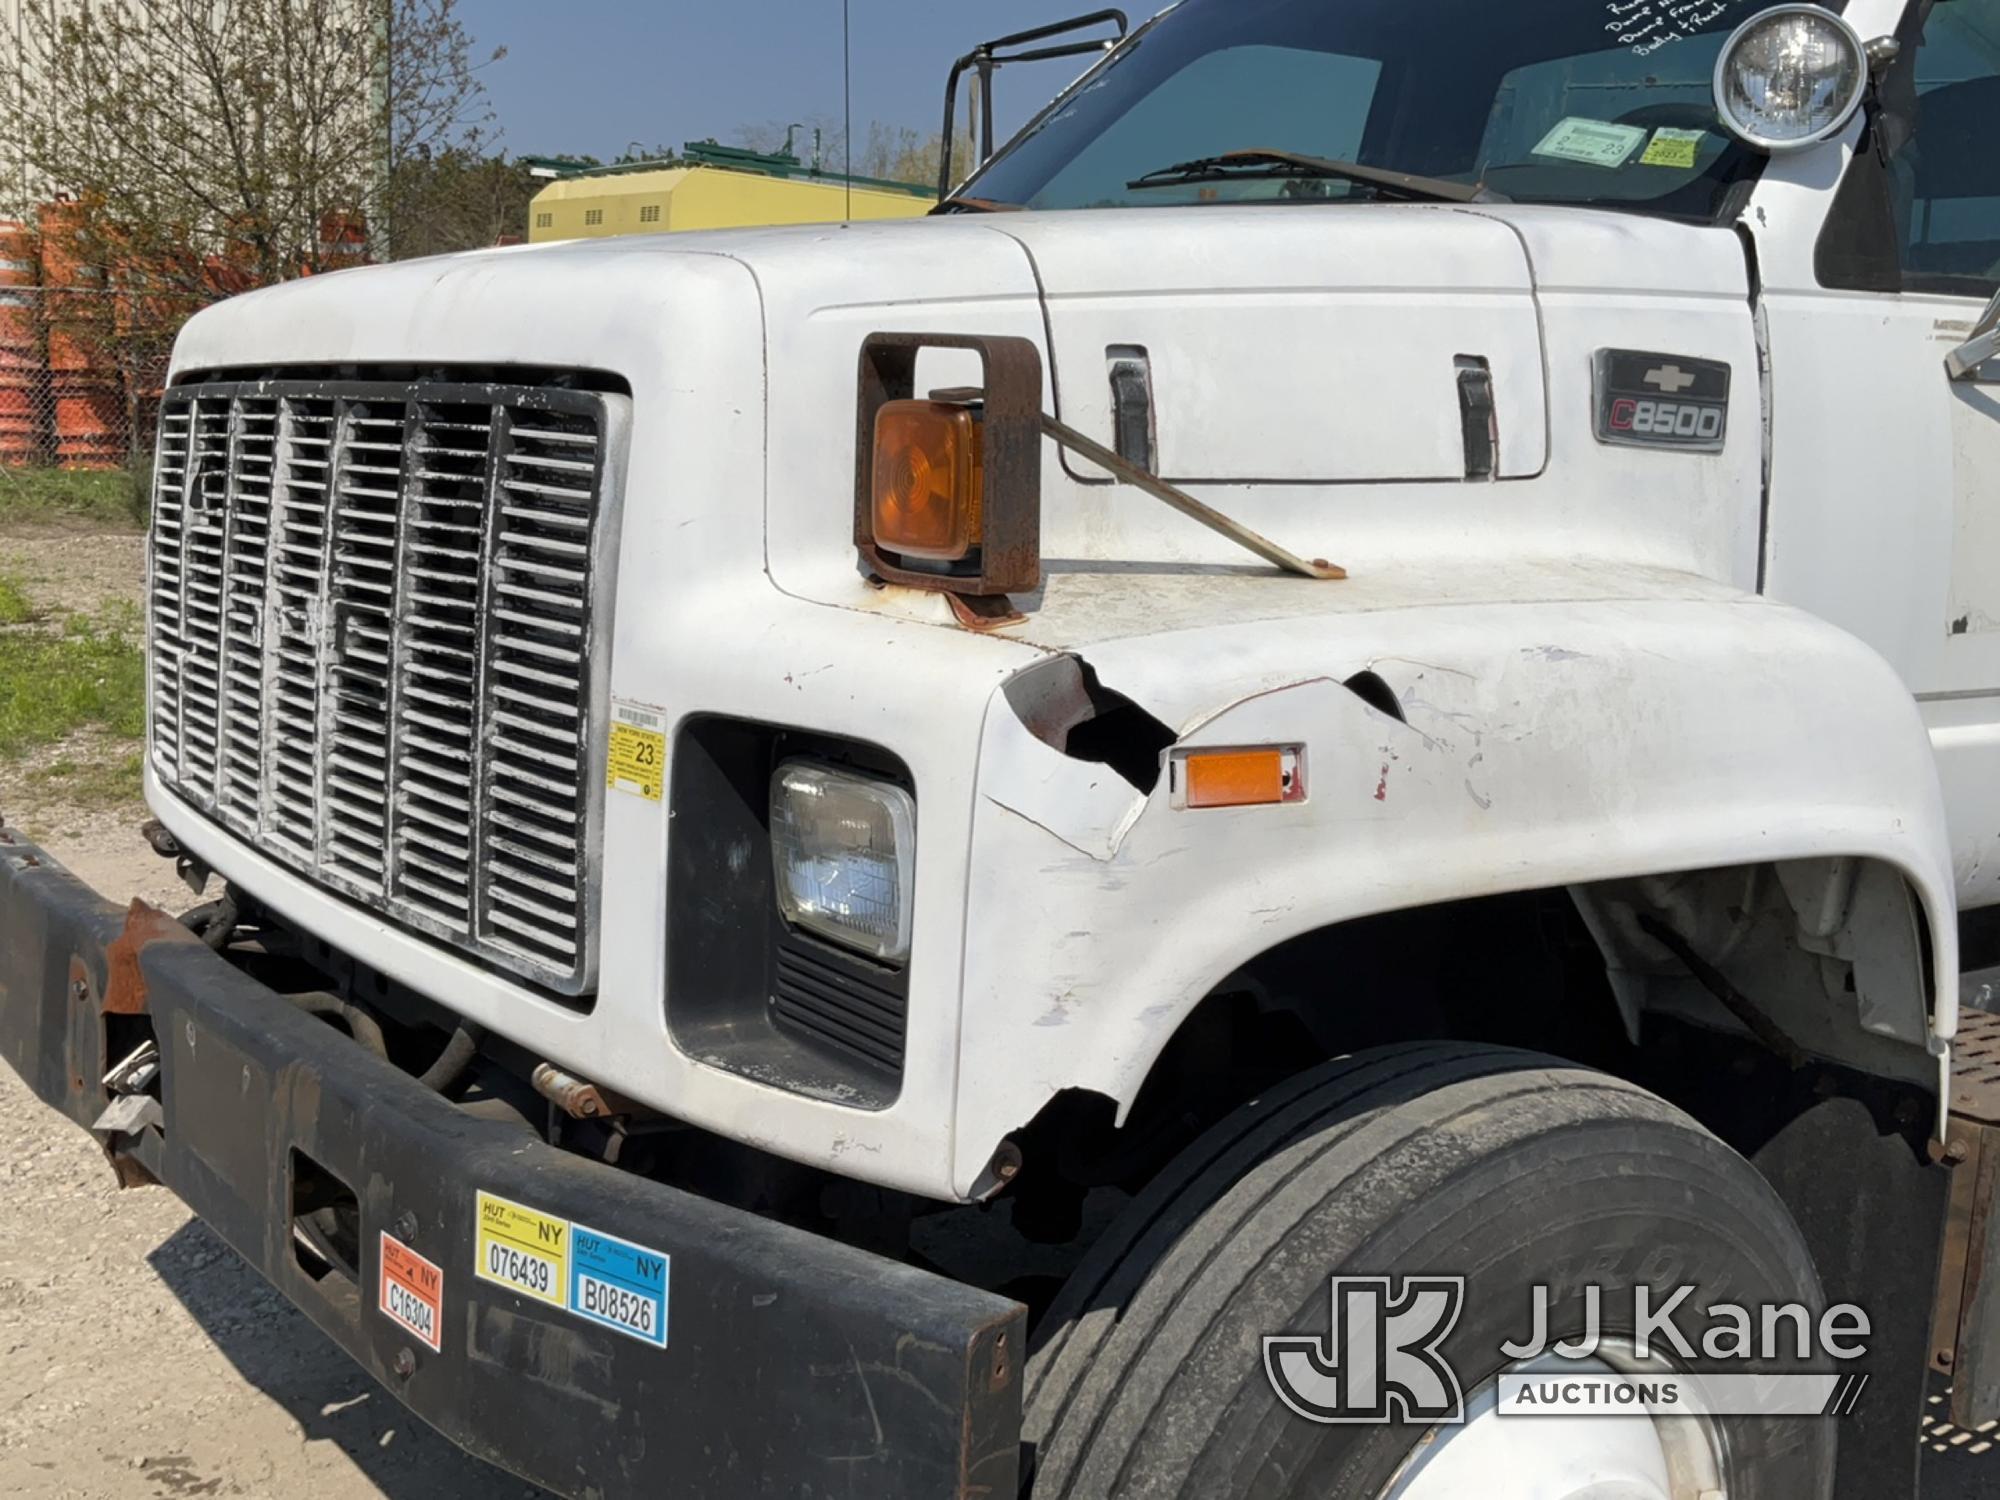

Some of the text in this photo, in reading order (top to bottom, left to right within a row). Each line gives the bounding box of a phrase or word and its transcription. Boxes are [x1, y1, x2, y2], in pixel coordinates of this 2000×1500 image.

[1632, 31, 1683, 56] Body
[1689, 2, 1728, 27] Rust
[1601, 142, 1626, 157] 23
[1609, 398, 1722, 438] C8500
[635, 741, 655, 766] 23
[483, 1201, 563, 1246] HUT NY
[420, 1266, 438, 1291] NY
[489, 1242, 550, 1293] 076439
[577, 1235, 663, 1282] HUT NY
[389, 1282, 433, 1338] C16304
[584, 1278, 652, 1333] B08526
